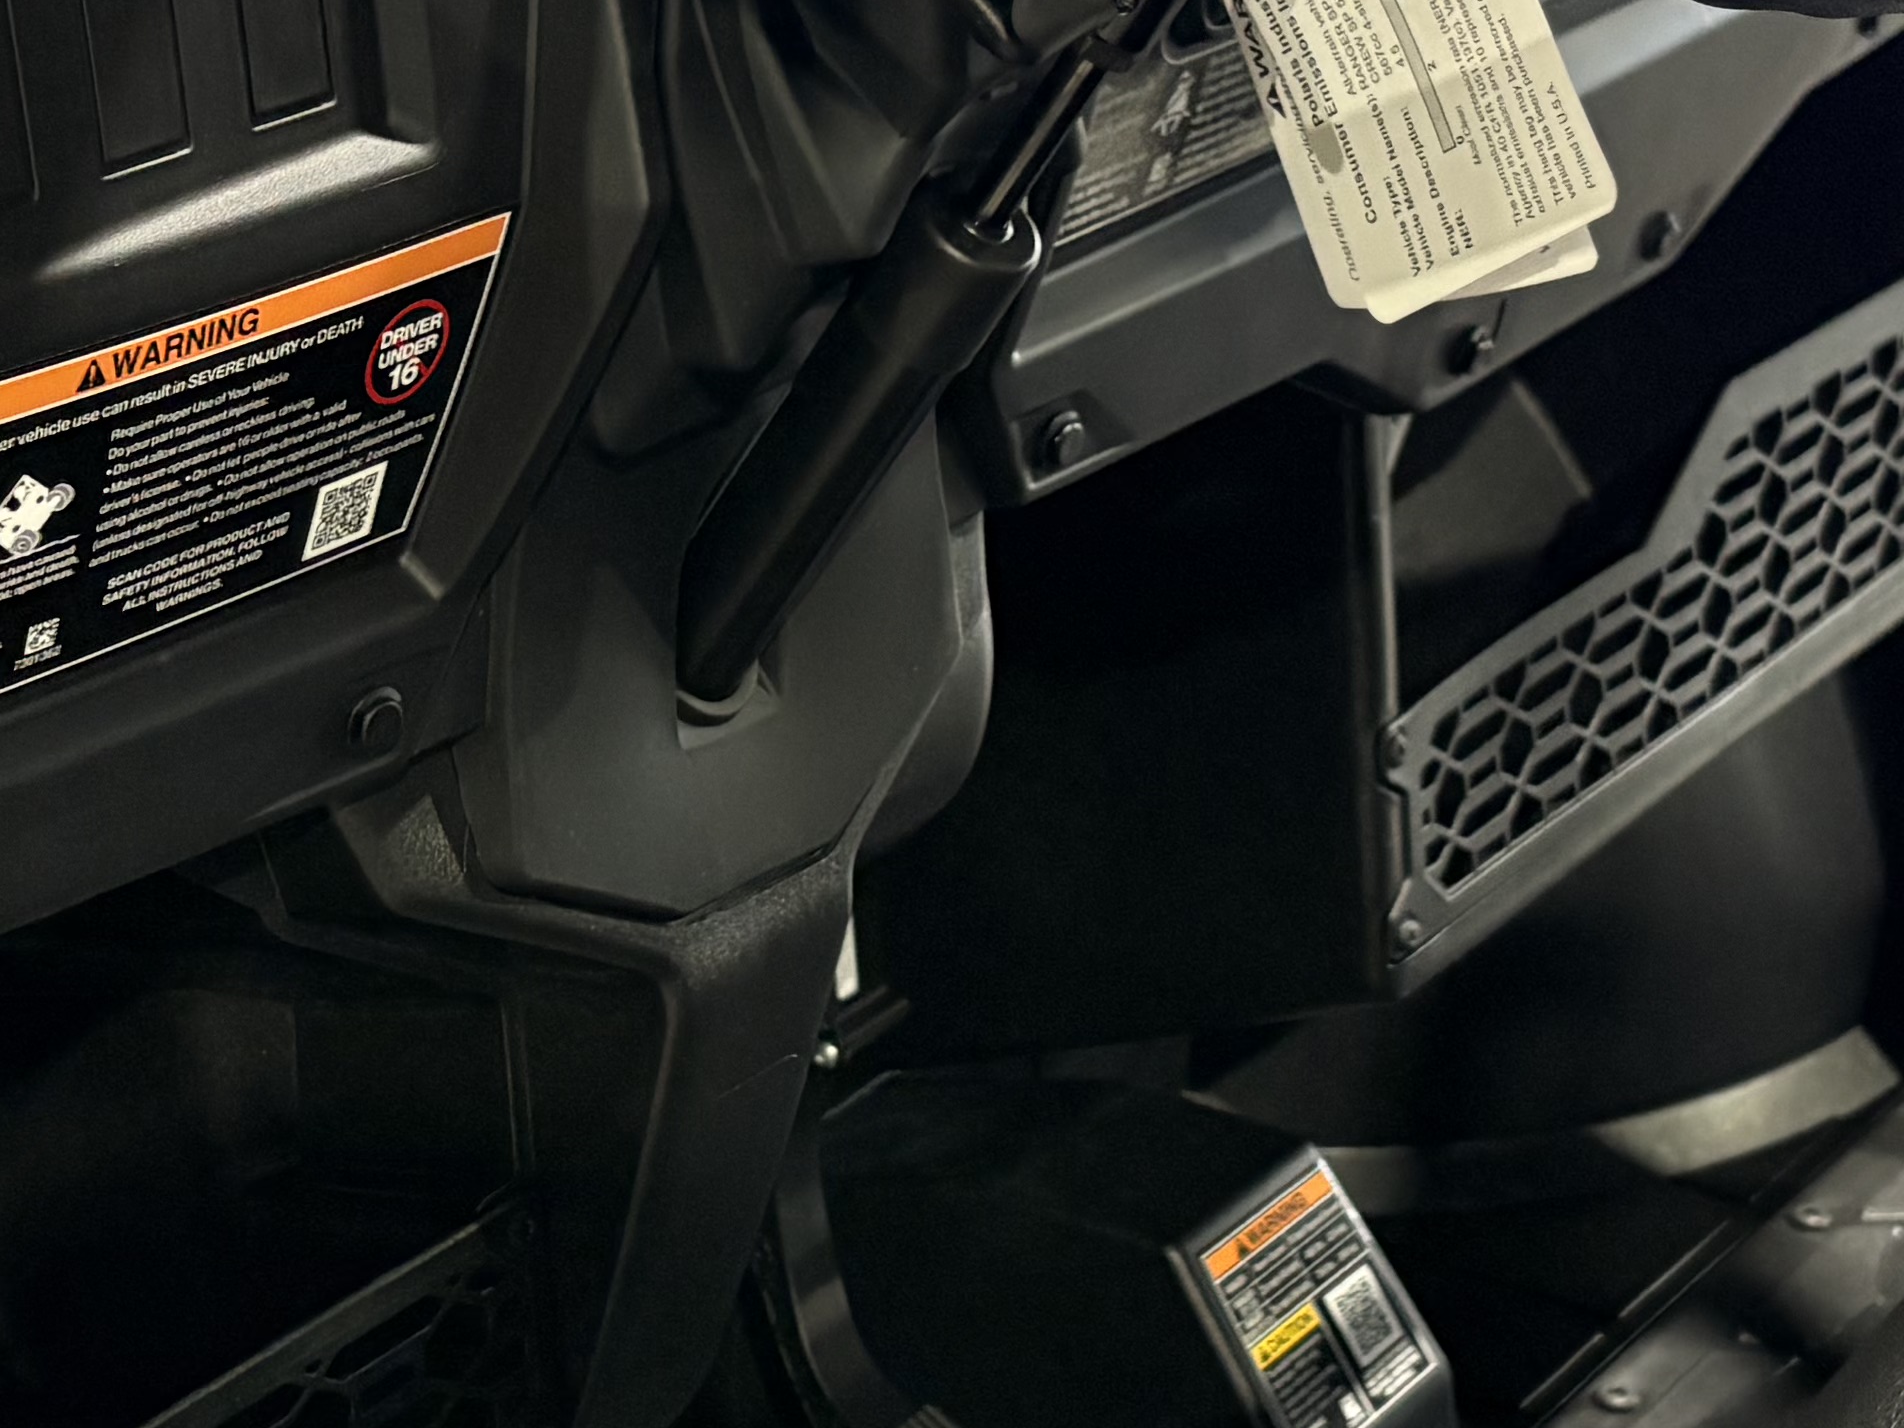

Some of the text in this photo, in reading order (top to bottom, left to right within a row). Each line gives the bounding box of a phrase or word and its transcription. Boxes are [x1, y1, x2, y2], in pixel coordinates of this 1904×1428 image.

[1321, 0, 1338, 21] SP
[1341, 10, 1359, 32] SP
[1284, 14, 1338, 117] Emissions
[1332, 22, 1369, 90] RANGER
[1353, 34, 1380, 84] CREW
[1388, 44, 1405, 68] 4.5
[1426, 59, 1437, 71] 2
[1501, 64, 1516, 82] be
[1286, 57, 1324, 127] Polaris
[1525, 87, 1545, 123] been
[1543, 81, 1568, 124] U.S.A.
[1539, 124, 1556, 150] has
[1331, 121, 1379, 224] Consumer
[107, 305, 263, 381] WARNING
[377, 310, 445, 351] DRIVER
[375, 332, 440, 371] UNDER
[15, 415, 72, 446] vehicle
[71, 409, 100, 428] use
[101, 399, 129, 418] can
[129, 382, 172, 409] result
[171, 377, 187, 395] in
[186, 355, 248, 390] SEVERE
[246, 337, 300, 368] INJURY
[300, 335, 315, 349] or
[316, 314, 365, 343] DEATH
[383, 354, 423, 393] 16
[107, 444, 126, 460] Do
[101, 577, 150, 606] SAFETY
[237, 523, 289, 553] FOLLOW
[106, 509, 291, 589] SCAN CODE FOR PRODUCT AND
[122, 547, 263, 612] ALL INSTRUCTIONS AND
[154, 575, 225, 613] WARNINGS.
